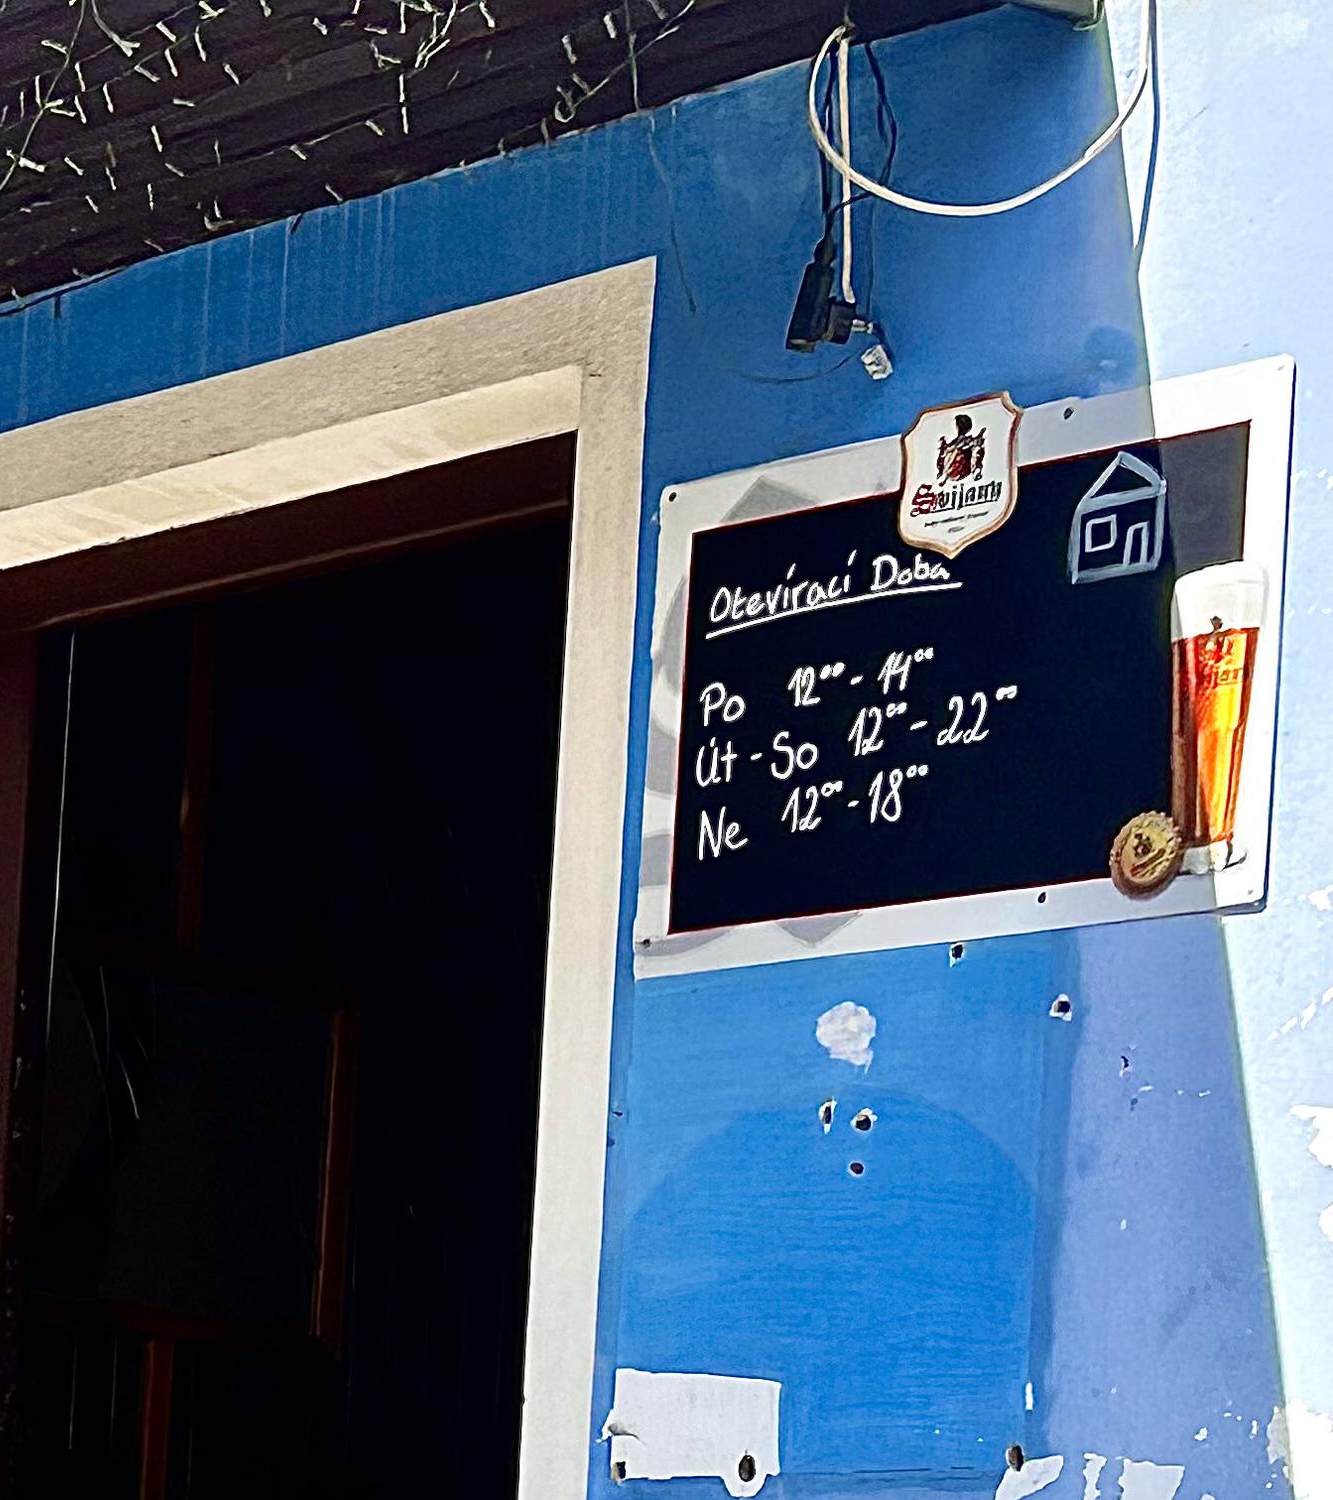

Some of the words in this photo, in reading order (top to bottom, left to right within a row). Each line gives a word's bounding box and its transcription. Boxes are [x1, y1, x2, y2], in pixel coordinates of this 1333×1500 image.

[709, 549, 858, 624] Otevírací
[869, 552, 951, 592] Doba
[699, 682, 746, 727] Po
[697, 805, 749, 861] Ne
